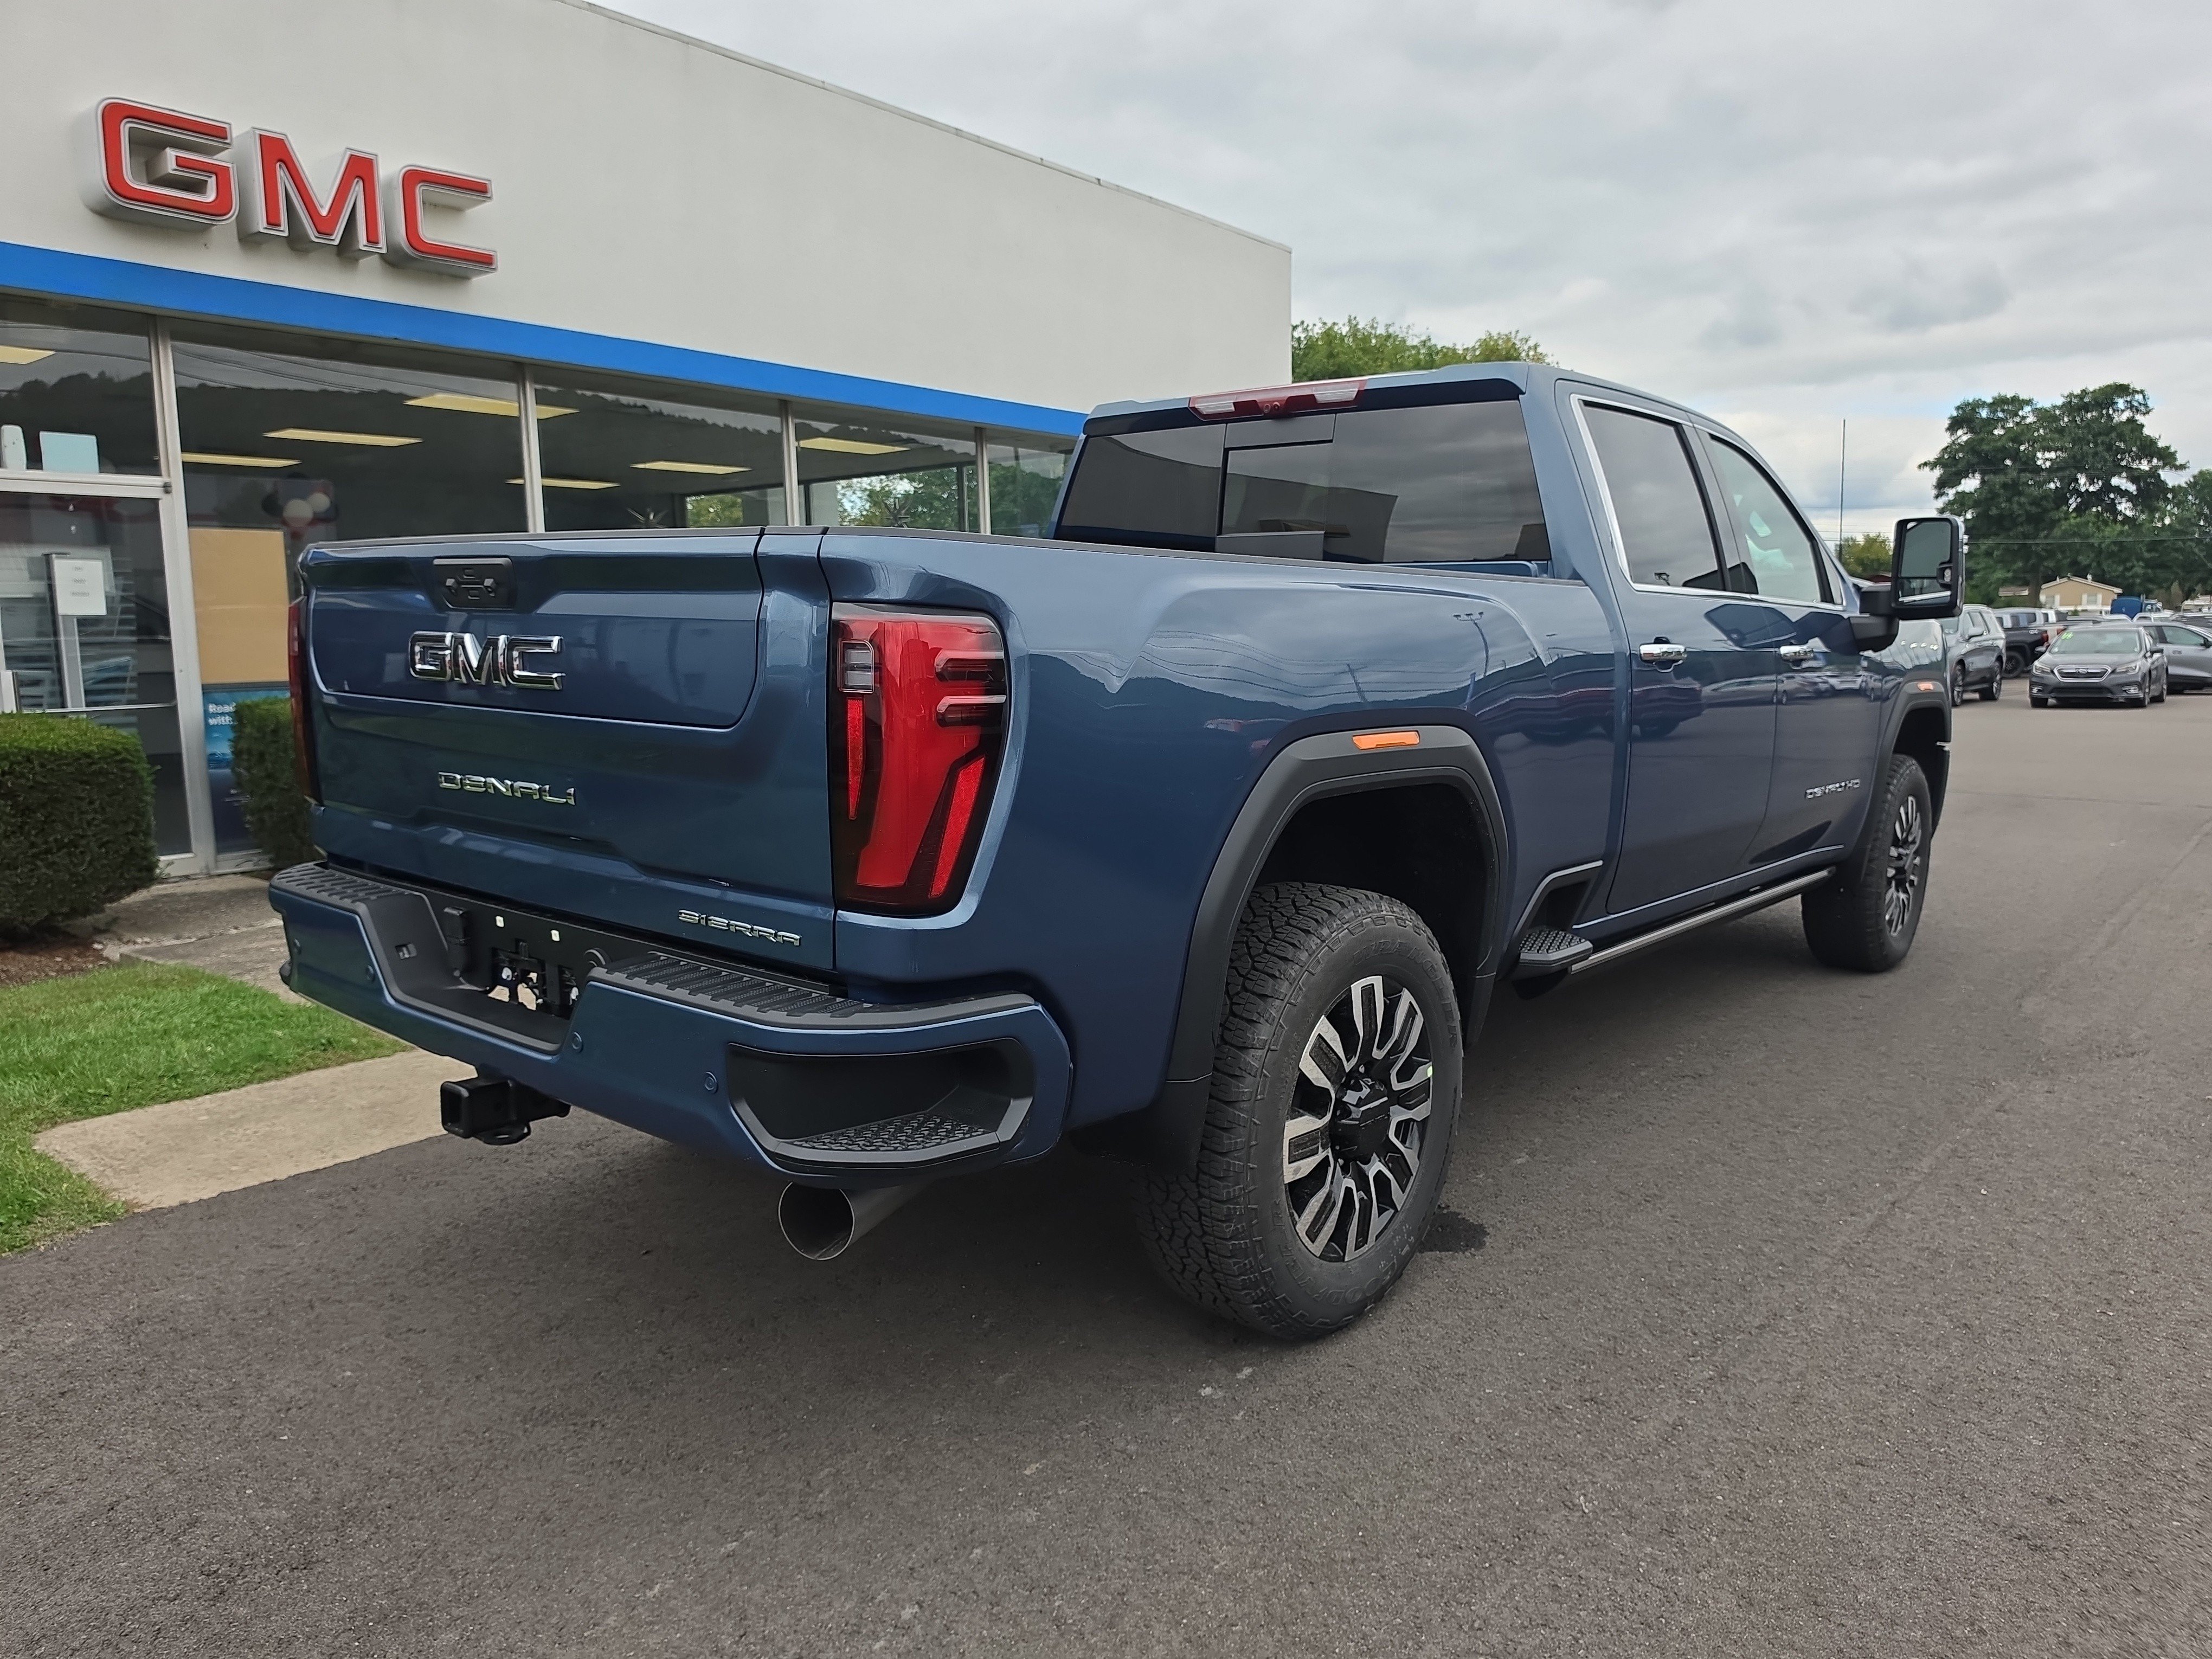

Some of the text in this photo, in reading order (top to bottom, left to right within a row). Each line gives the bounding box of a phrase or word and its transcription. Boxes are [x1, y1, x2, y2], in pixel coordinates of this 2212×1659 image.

[97, 97, 498, 274] GMC
[409, 631, 566, 691] GMC
[438, 771, 575, 805] DENALI
[678, 909, 801, 946] SIERRA
